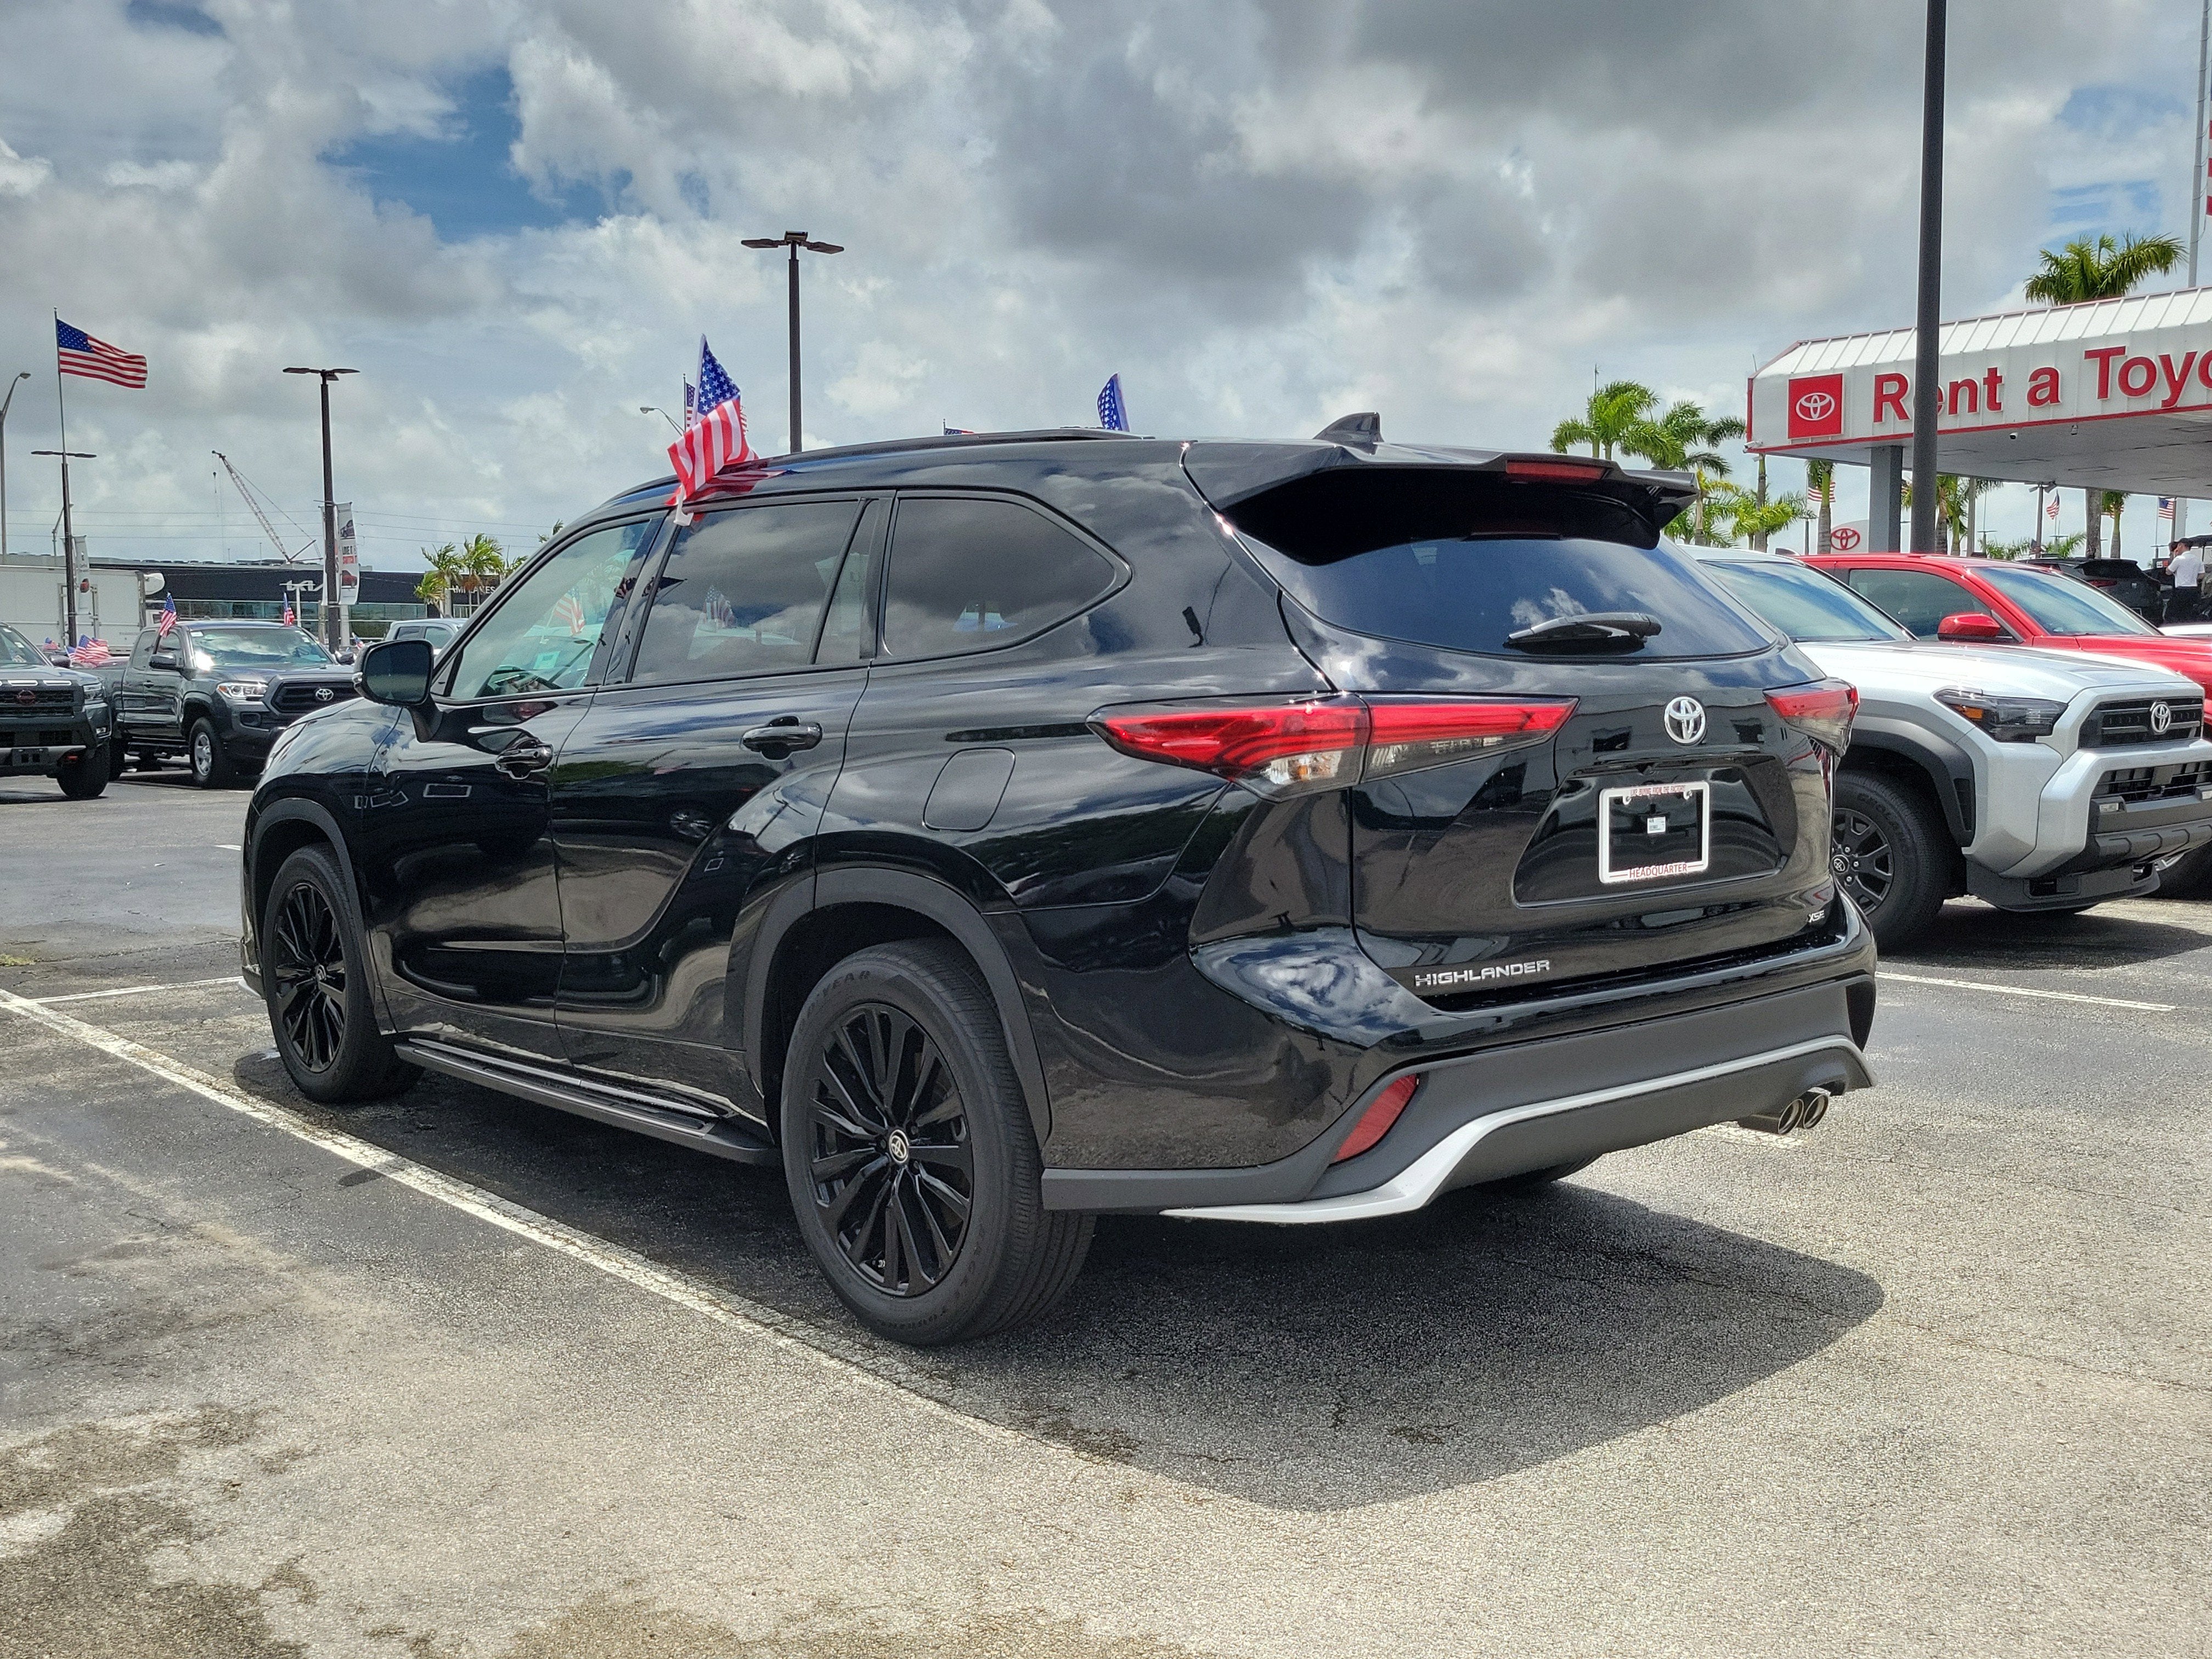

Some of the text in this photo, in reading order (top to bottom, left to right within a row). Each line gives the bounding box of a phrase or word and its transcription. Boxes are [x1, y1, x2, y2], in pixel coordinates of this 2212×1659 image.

[1874, 368, 2002, 424] Rnt
[2027, 366, 2061, 408] a
[1629, 863, 1688, 878] HEADQUARTER
[1808, 910, 1825, 923] XSE
[1414, 960, 1550, 987] HIGHLANDER
